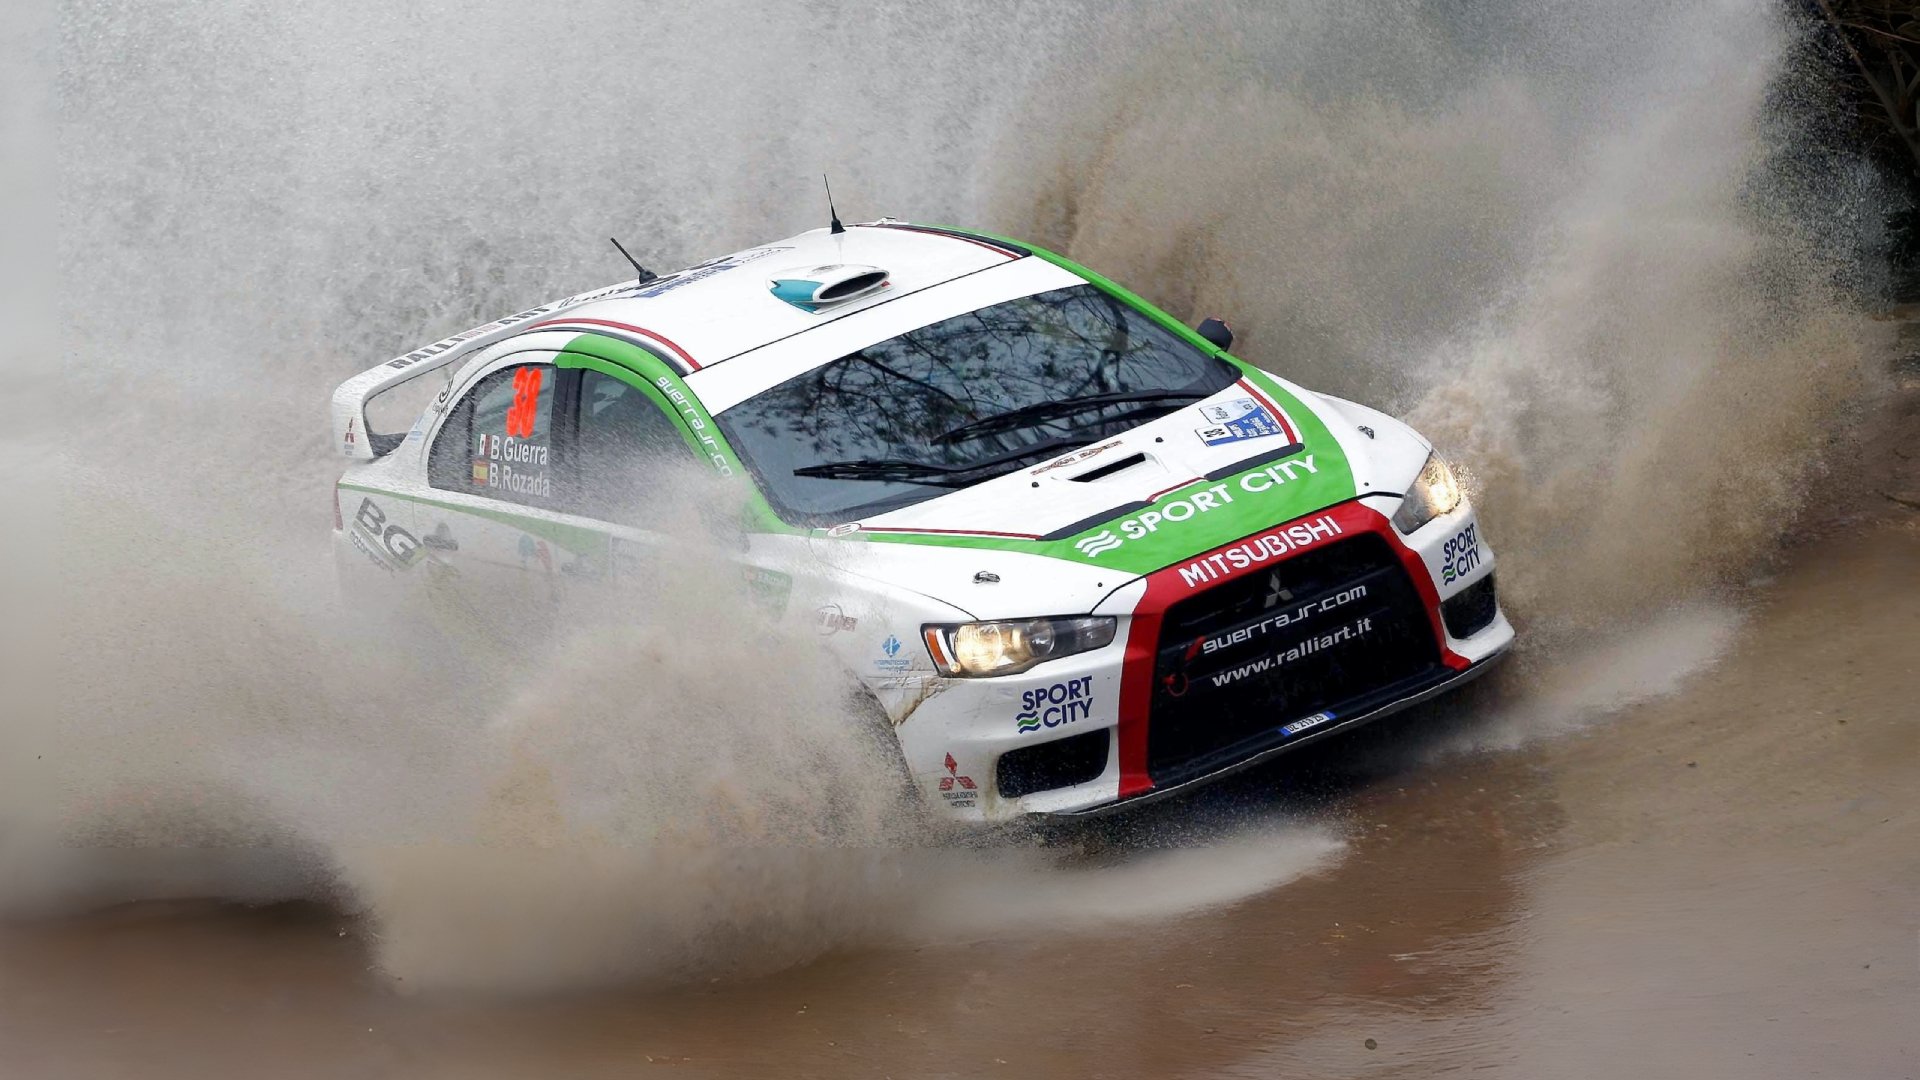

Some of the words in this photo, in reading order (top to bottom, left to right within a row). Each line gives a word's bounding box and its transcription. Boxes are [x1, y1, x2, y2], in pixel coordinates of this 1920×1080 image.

[491, 434, 548, 466] B.Guerra
[490, 463, 550, 497] B.Rozada
[1120, 484, 1234, 540] SPORT
[1239, 455, 1318, 492] CITY
[356, 497, 424, 565] BG
[1443, 522, 1477, 563] SPORT
[1178, 515, 1343, 588] MITSUBISHI
[1457, 544, 1480, 576] CITY
[1212, 617, 1372, 687] www.ralliart.it
[1022, 675, 1092, 711] SPORT
[1043, 697, 1093, 728] CITY
